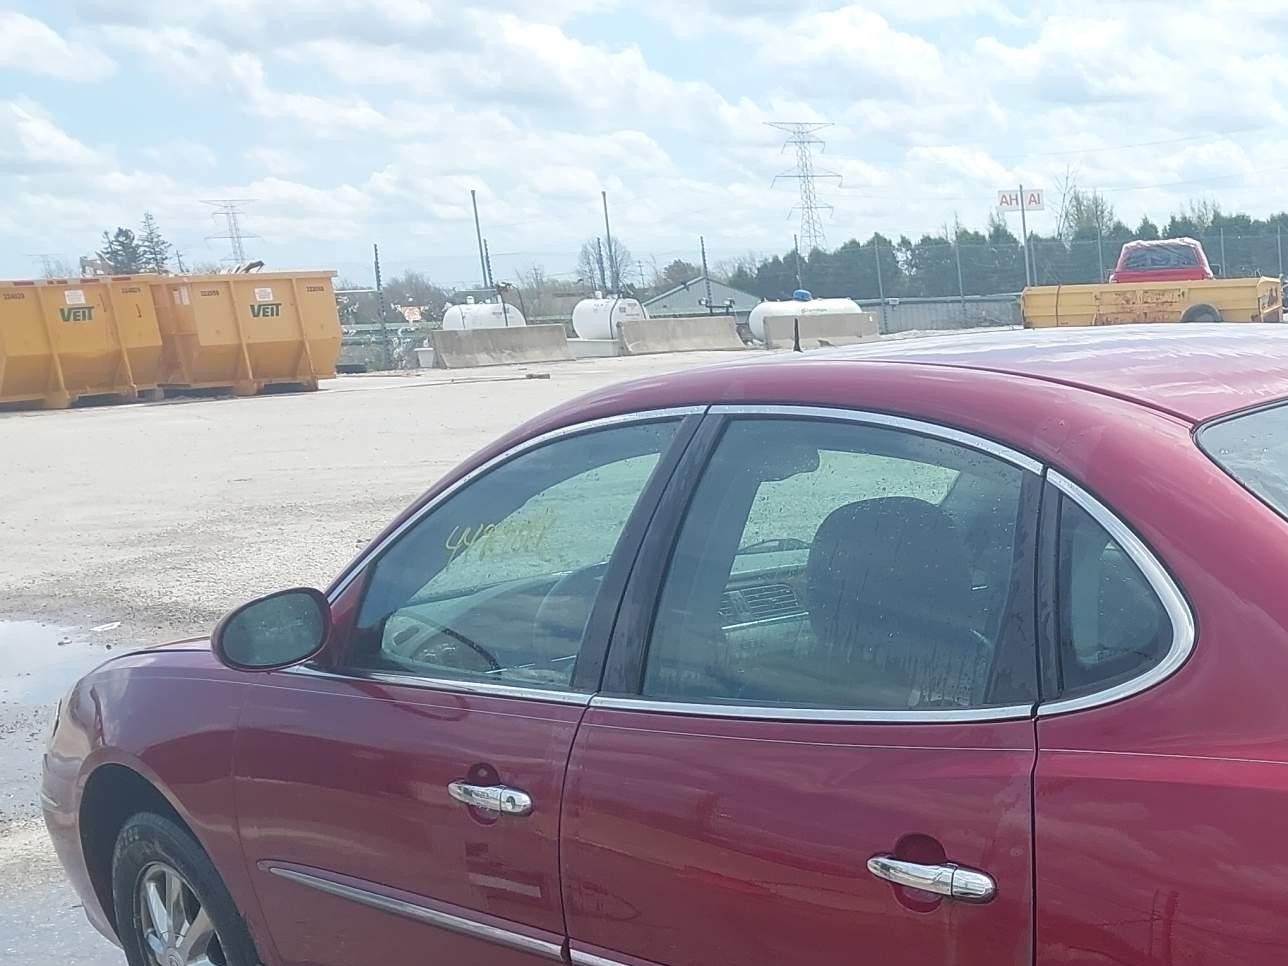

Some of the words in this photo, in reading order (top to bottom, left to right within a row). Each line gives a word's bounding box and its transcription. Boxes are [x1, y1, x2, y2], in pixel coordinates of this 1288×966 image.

[999, 193, 1019, 206] AH
[60, 306, 94, 322] VEIT
[250, 303, 282, 317] VEIT
